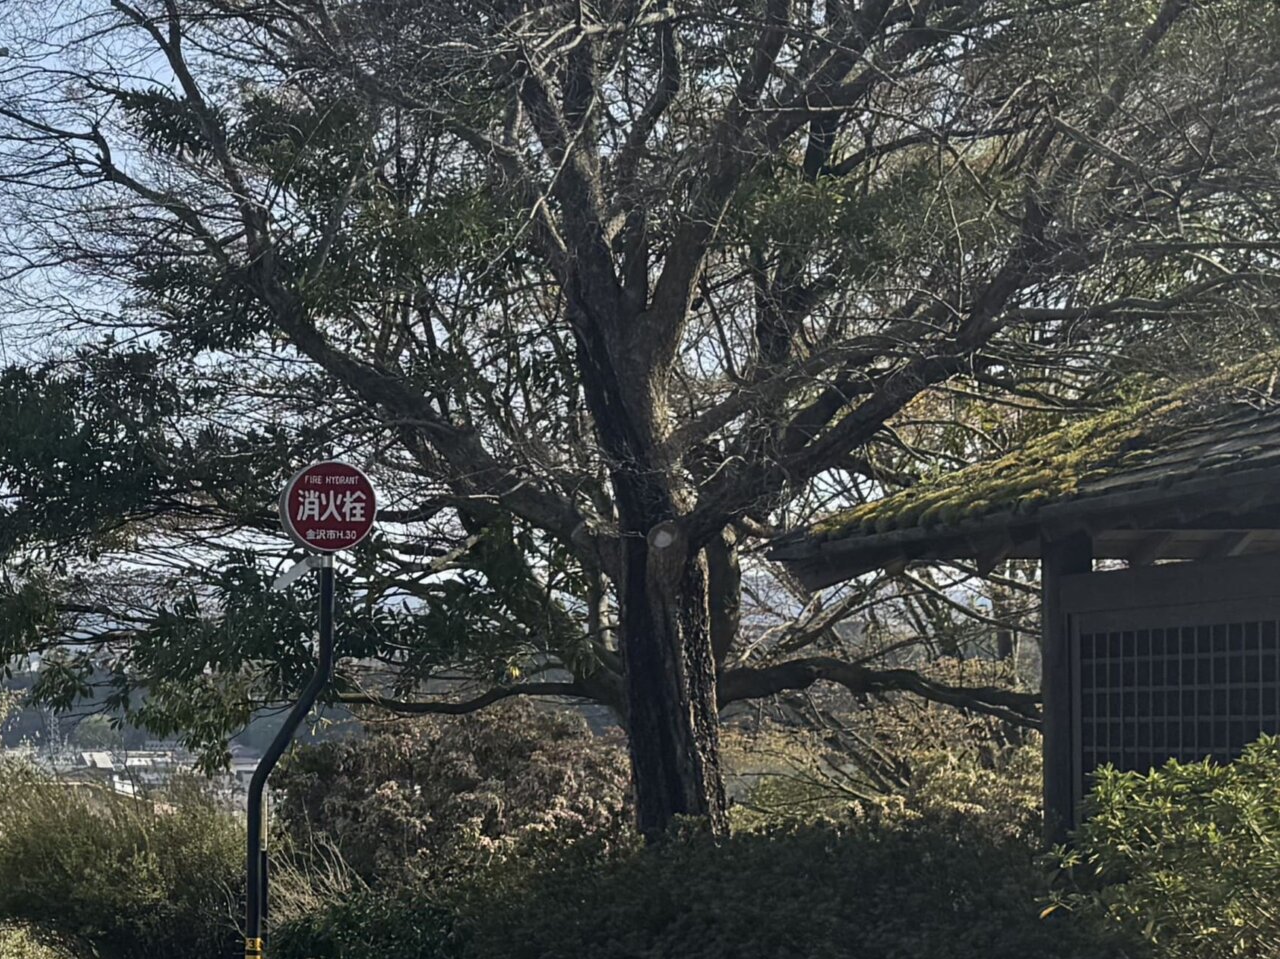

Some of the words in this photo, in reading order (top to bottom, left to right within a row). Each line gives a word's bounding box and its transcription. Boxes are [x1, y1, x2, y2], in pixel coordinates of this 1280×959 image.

[304, 475, 322, 484] FIRE
[325, 475, 359, 485] HYDRANT
[297, 490, 367, 522] 消火栓
